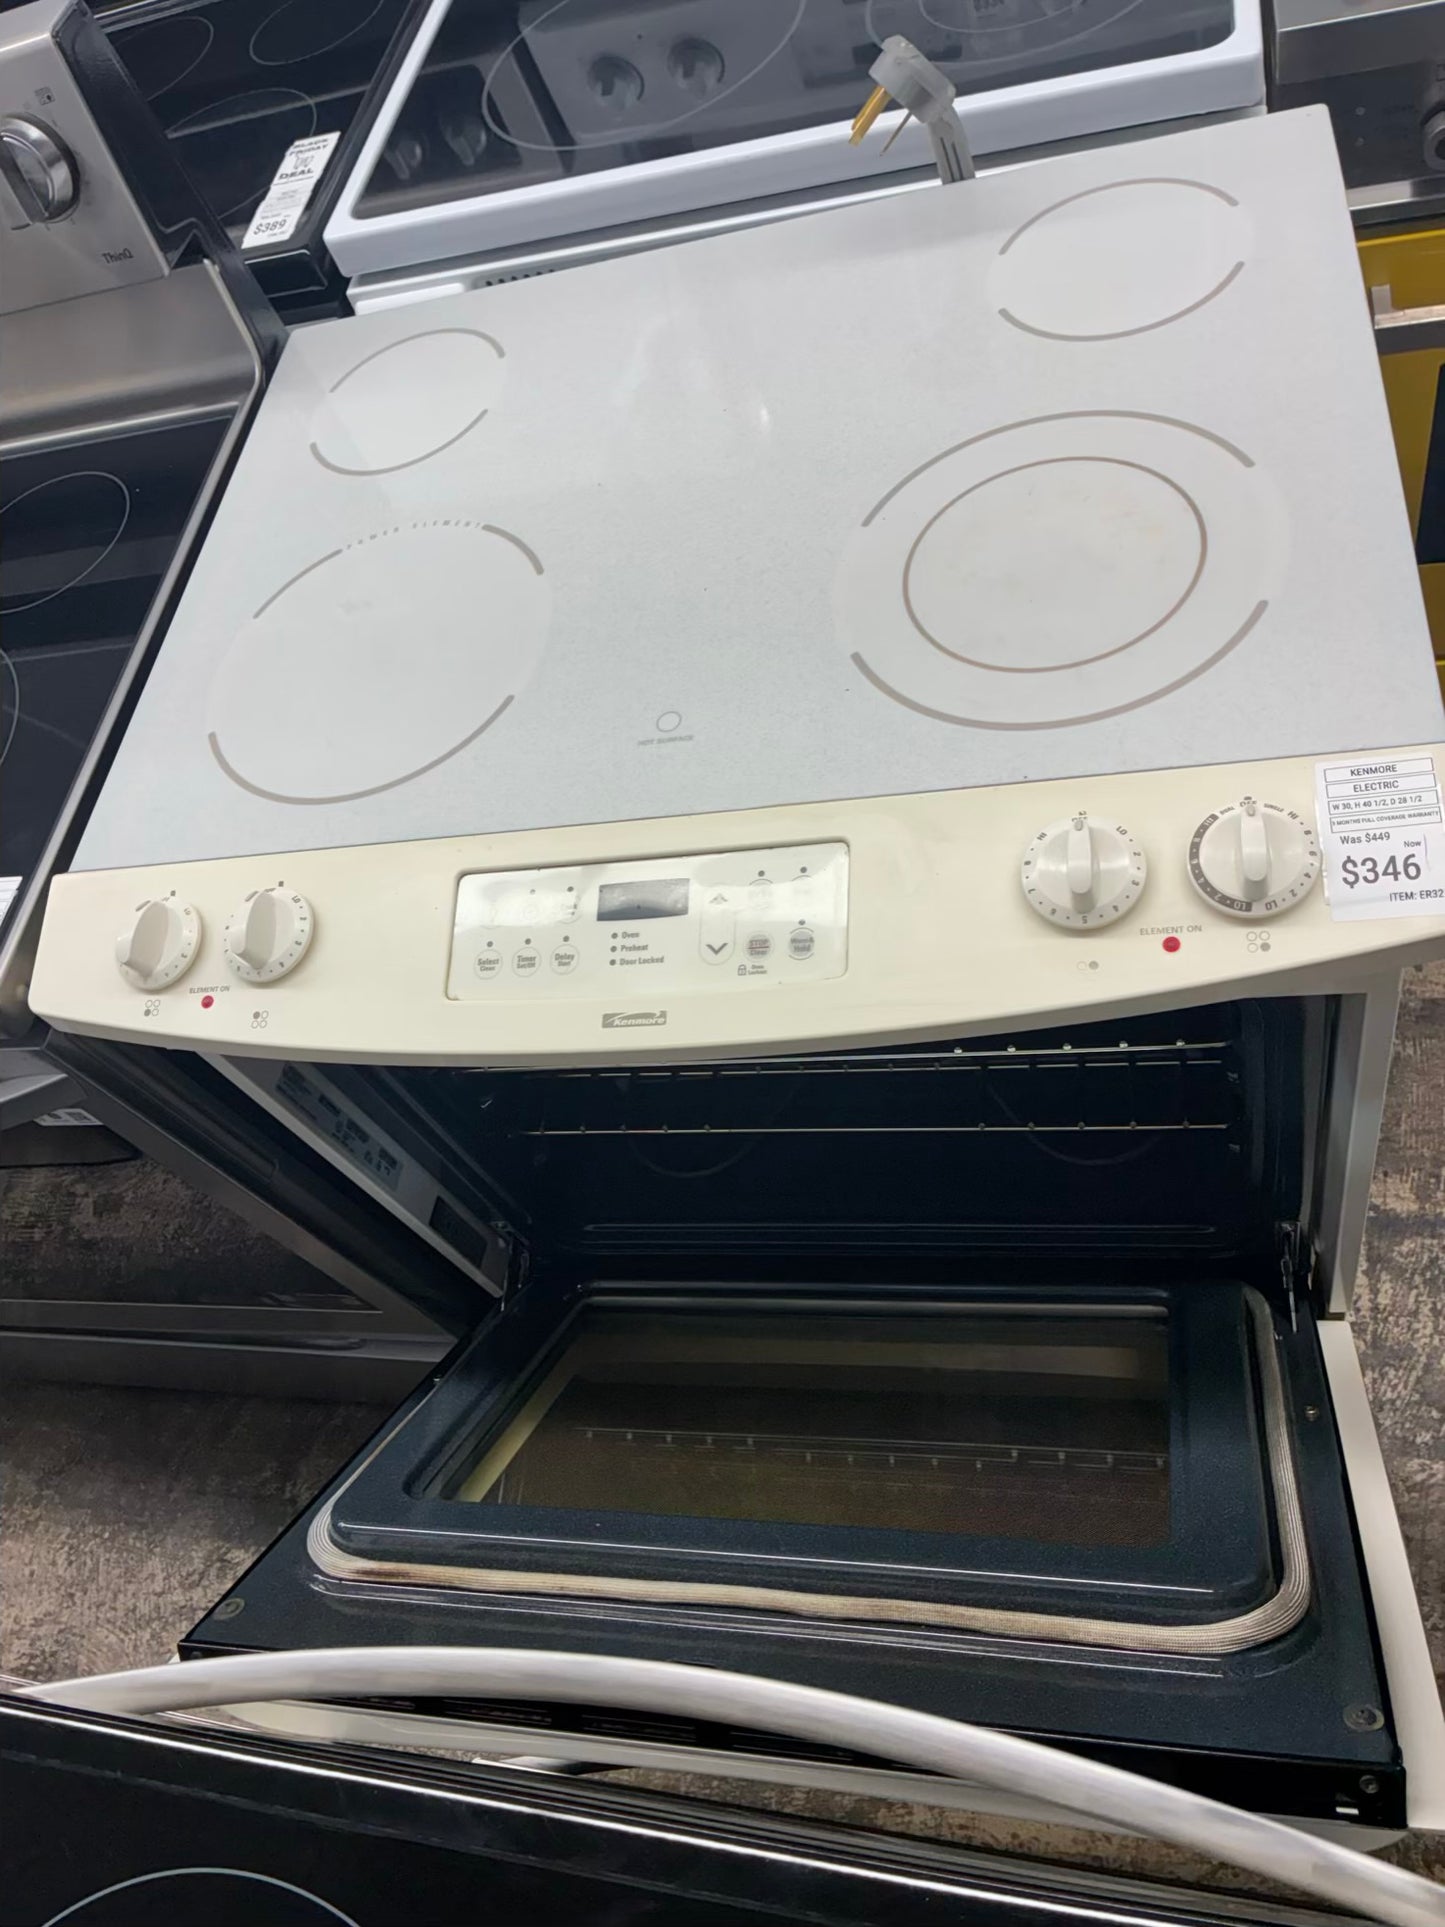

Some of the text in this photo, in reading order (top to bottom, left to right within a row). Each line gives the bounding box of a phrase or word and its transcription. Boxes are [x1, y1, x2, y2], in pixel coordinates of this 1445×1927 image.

[280, 168, 314, 180] DEAL
[253, 220, 287, 236] $389
[102, 248, 134, 264] ThinQ
[1350, 764, 1398, 776] KENMORE
[1353, 780, 1399, 793] ELECTRIC
[1342, 802, 1353, 810] 30,
[1362, 800, 1372, 808] 40
[1374, 798, 1389, 807] 1/2,
[1390, 798, 1397, 806] D
[1398, 796, 1408, 804] 28
[1410, 794, 1422, 803] 1/2
[1336, 818, 1360, 826] MONTHS
[1376, 814, 1406, 822] COVERAGE
[1408, 810, 1439, 818] WARRANTY
[1340, 832, 1391, 845] Was $449
[1404, 840, 1422, 848] Now
[1341, 853, 1422, 889] $346
[1389, 891, 1417, 902] ITEM:
[622, 931, 641, 940] Oven
[1140, 924, 1202, 936] ELEMENT ON
[620, 944, 649, 952] Preheat
[477, 958, 500, 966] Select
[516, 954, 537, 964] Timer
[554, 952, 576, 962] Delay
[619, 956, 664, 966] Door Locked
[189, 986, 219, 994] ELEMENT
[608, 1013, 666, 1027] Kenmore
